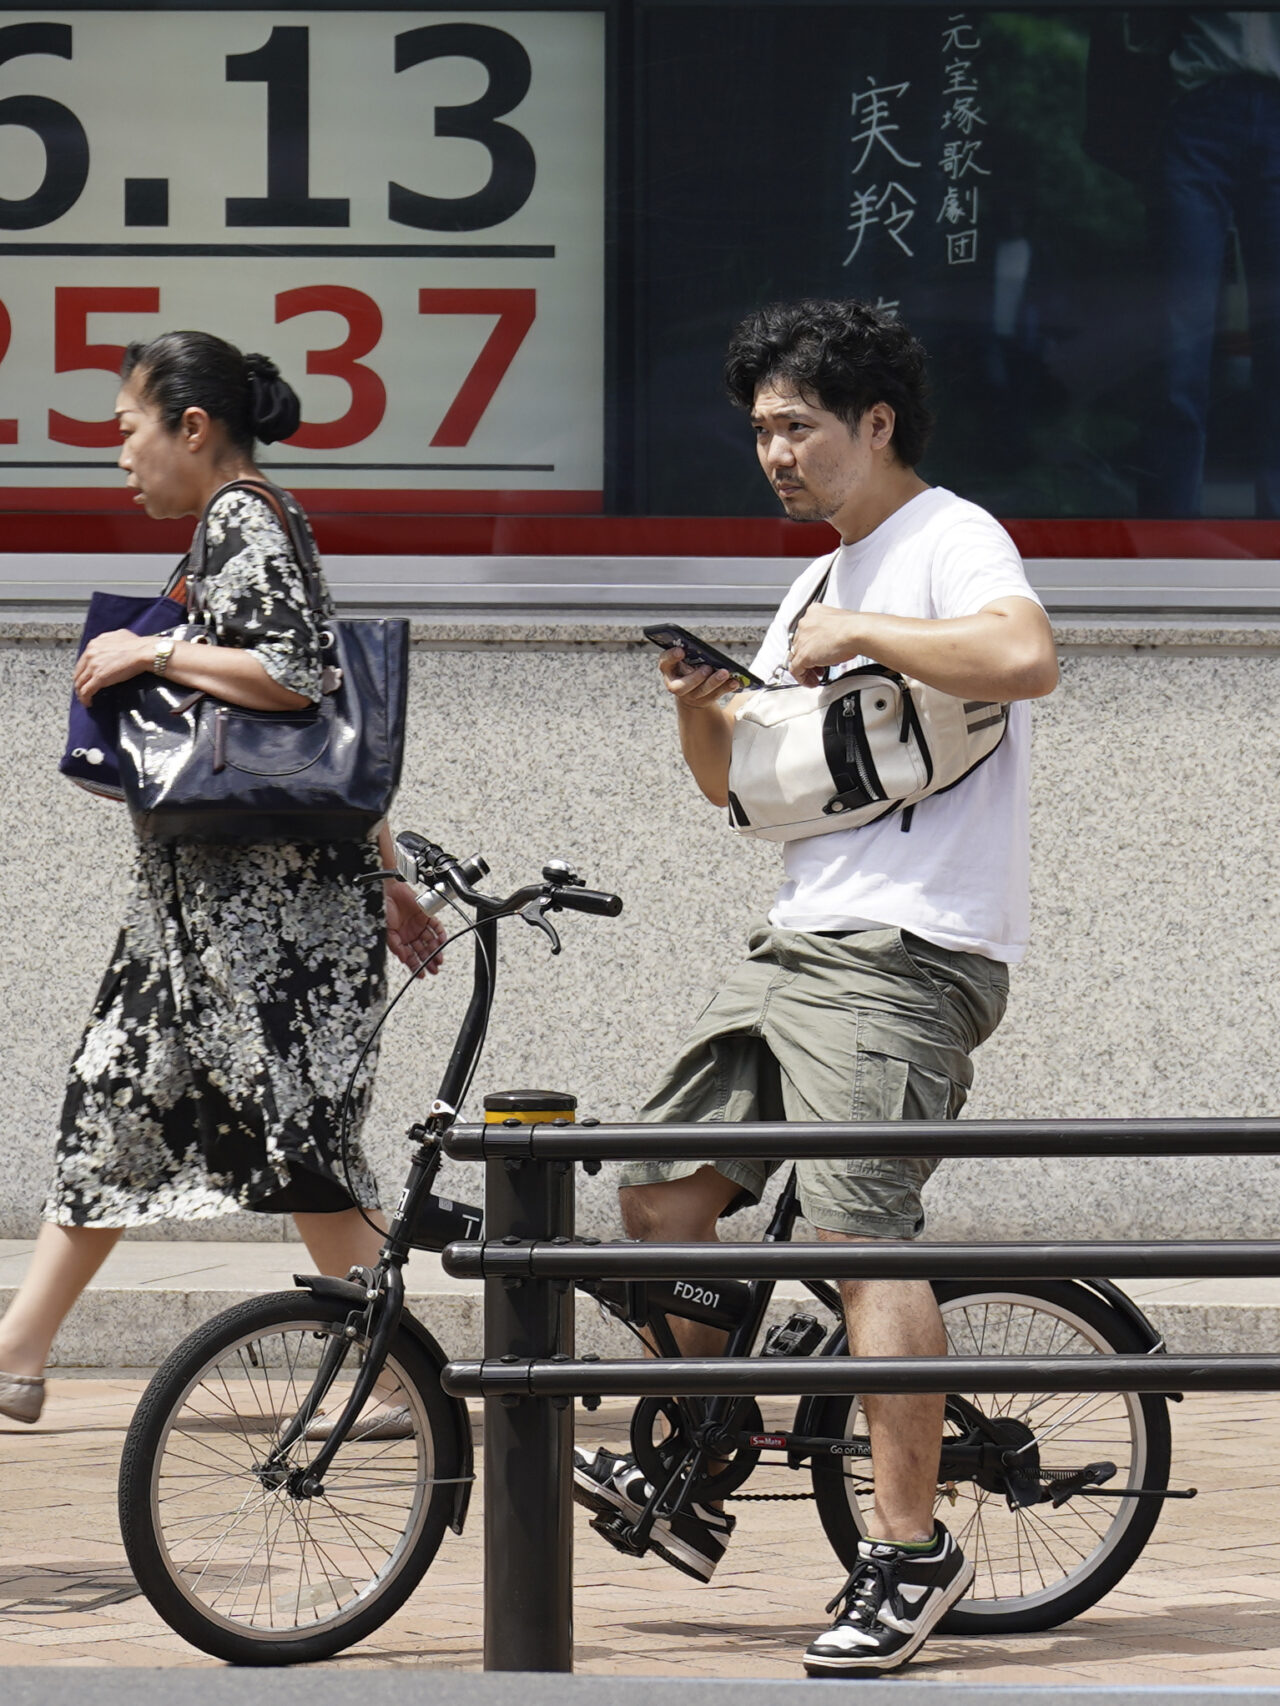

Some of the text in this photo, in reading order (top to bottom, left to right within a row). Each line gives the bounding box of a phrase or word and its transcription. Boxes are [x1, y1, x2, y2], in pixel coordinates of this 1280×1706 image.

[936, 14, 991, 264] 元宝塚歌劇団
[673, 1281, 720, 1308] FD201
